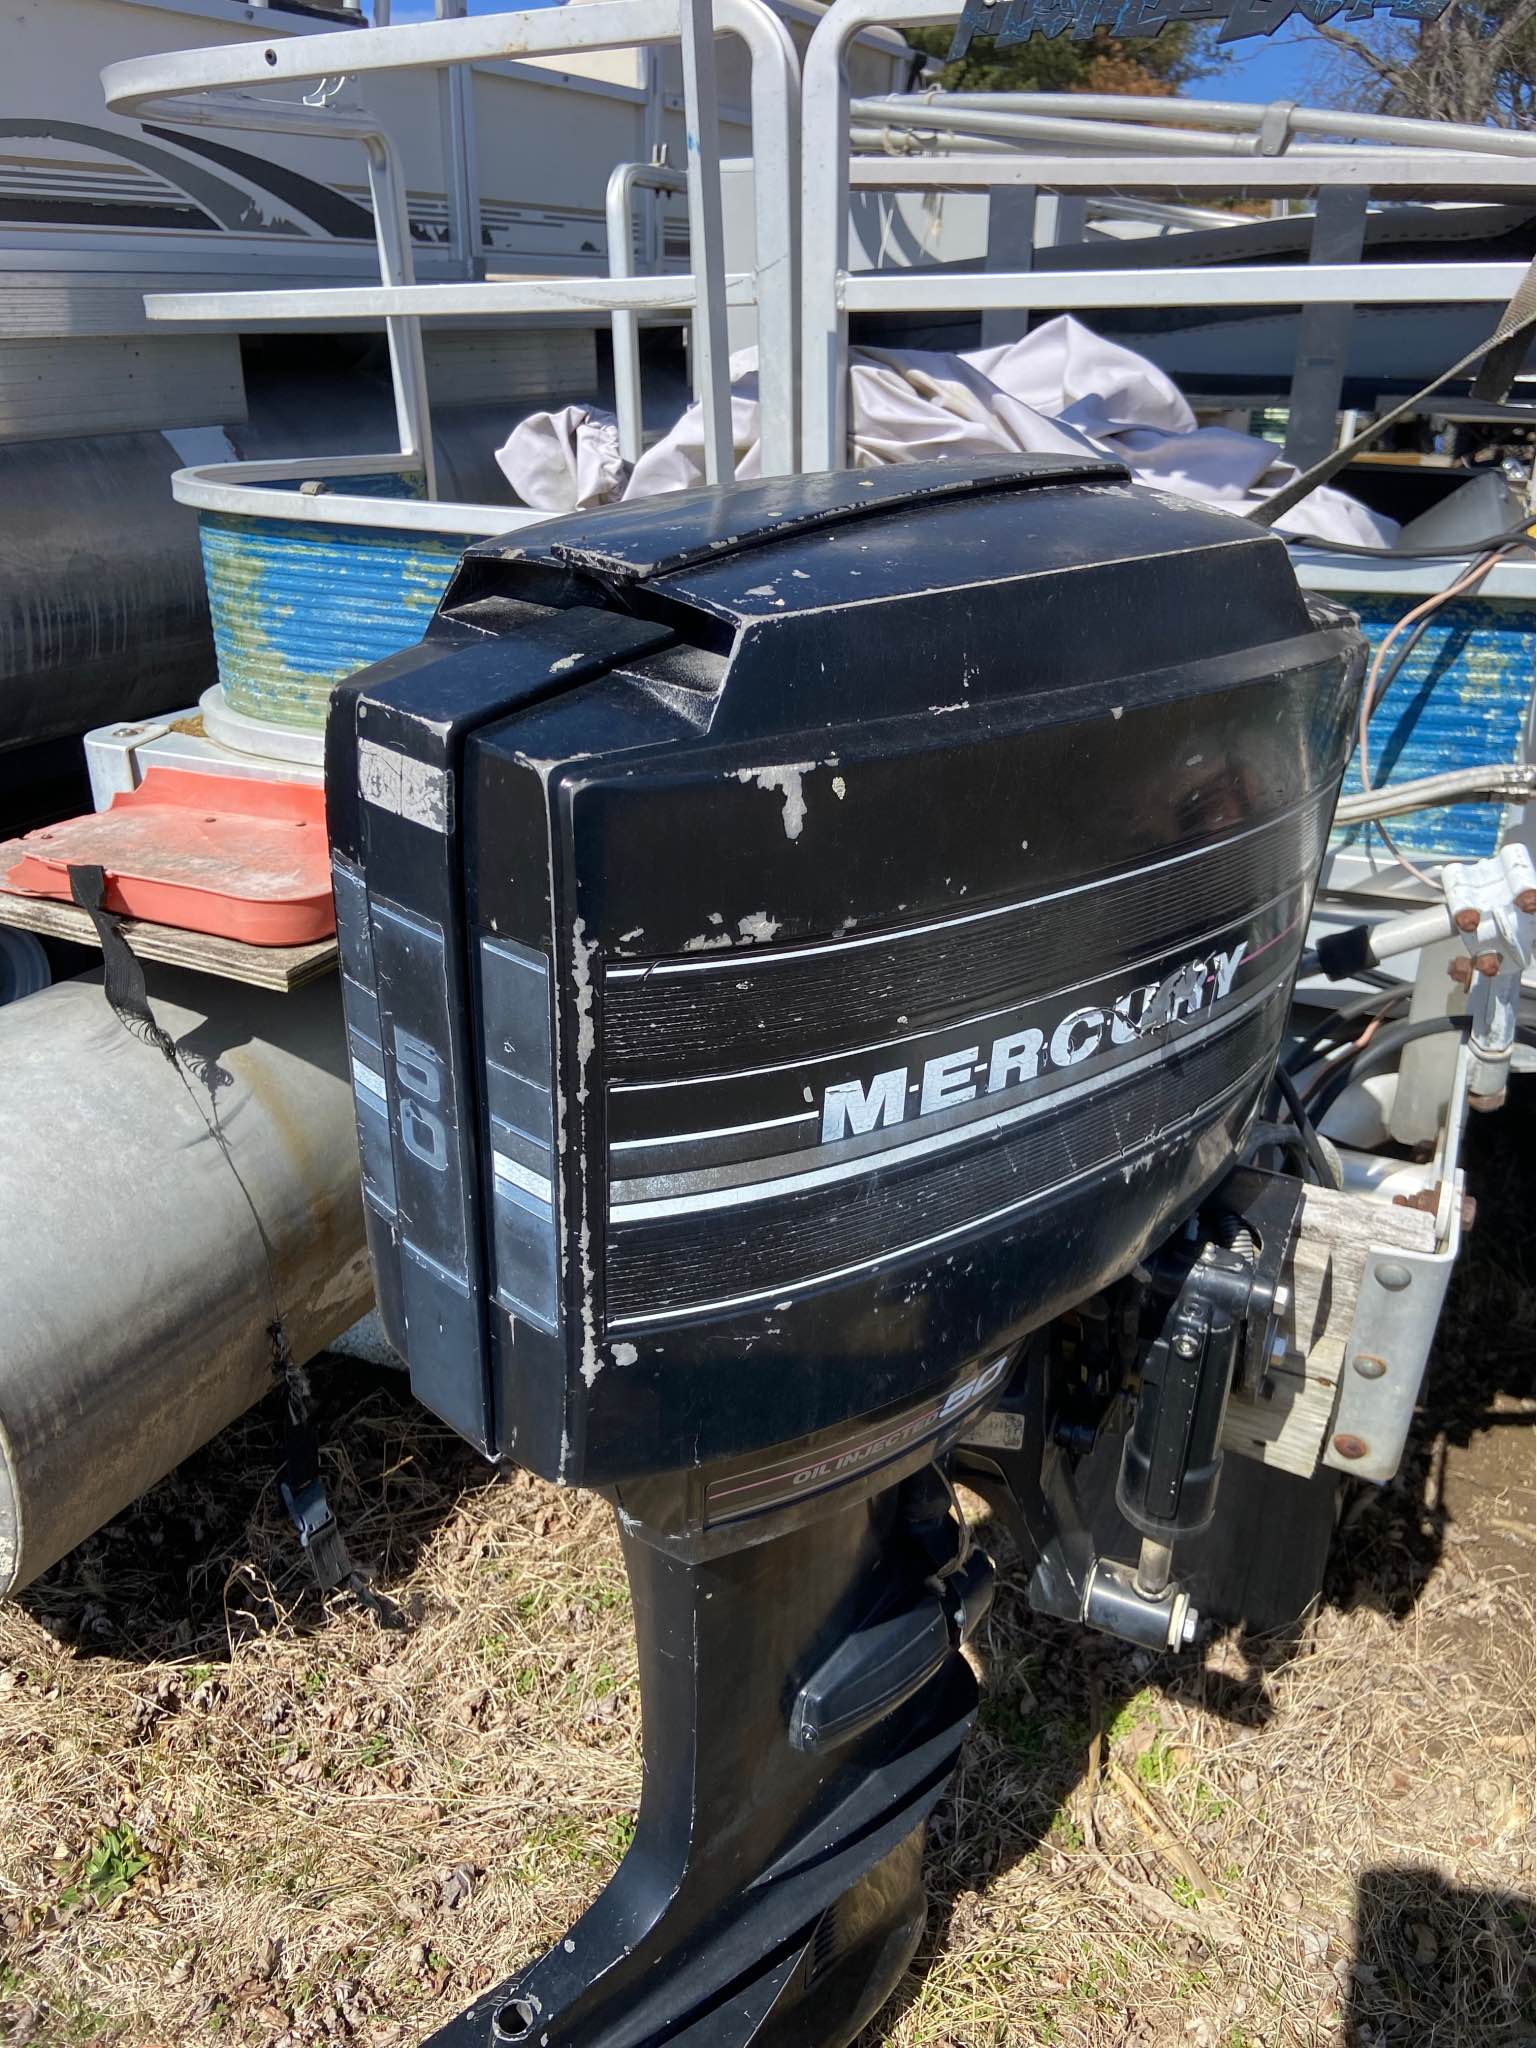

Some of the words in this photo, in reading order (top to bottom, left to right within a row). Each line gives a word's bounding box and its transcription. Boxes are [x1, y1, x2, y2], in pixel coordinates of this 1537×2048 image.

[393, 1024, 448, 1172] 50
[792, 1463, 831, 1485] OIL
[836, 1411, 939, 1471] INJECTED
[938, 1355, 1009, 1419] 50
